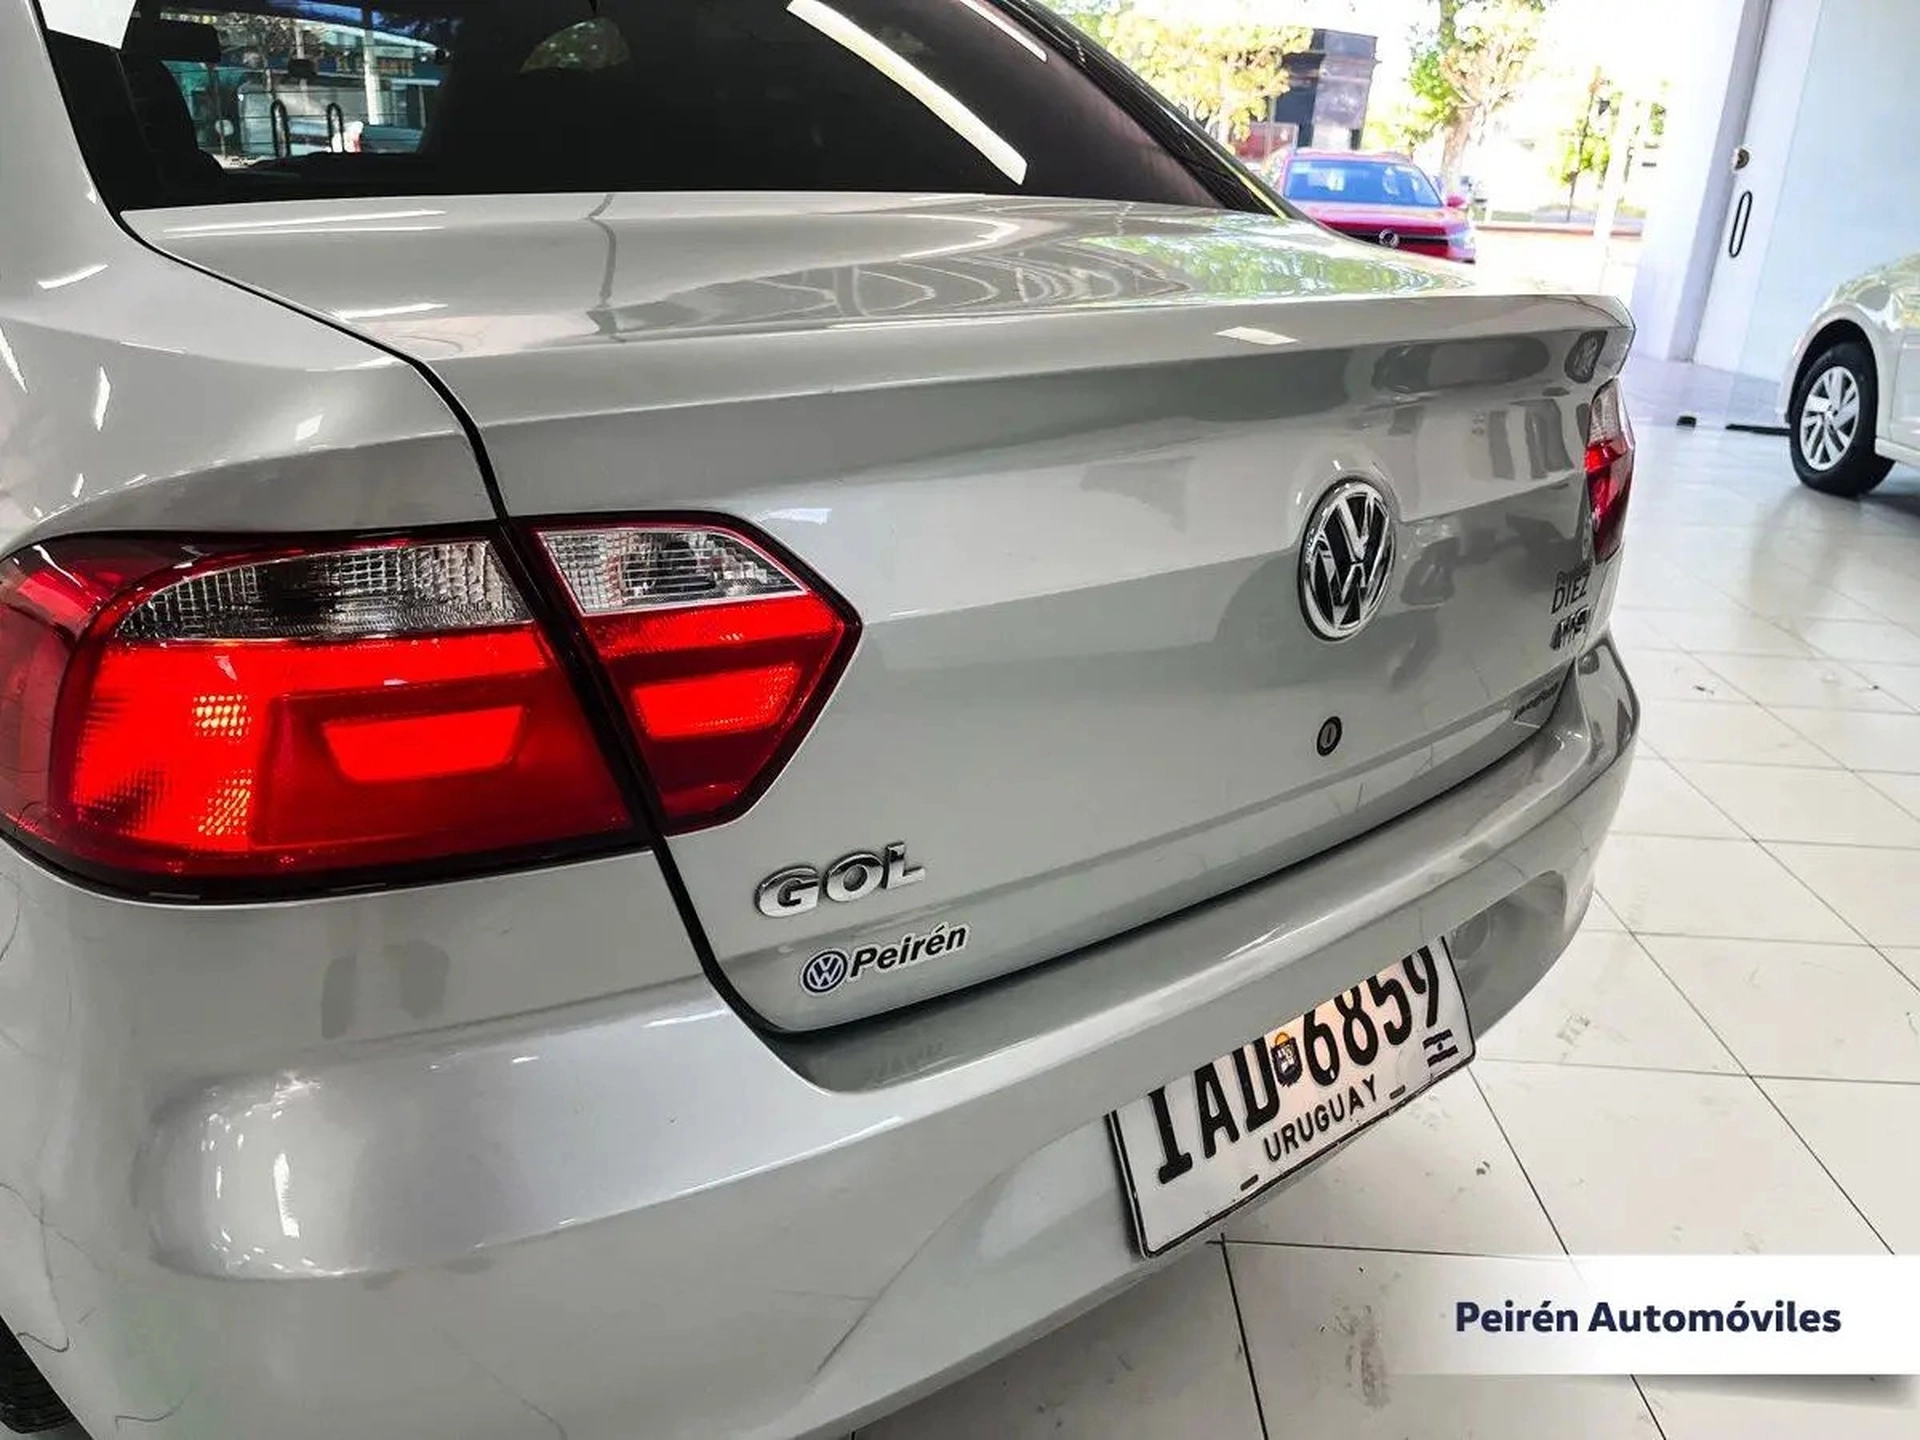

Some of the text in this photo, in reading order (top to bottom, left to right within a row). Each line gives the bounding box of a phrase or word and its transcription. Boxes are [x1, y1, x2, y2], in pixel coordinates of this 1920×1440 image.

[1298, 476, 1396, 641] VW
[754, 841, 926, 918] GOL
[850, 925, 967, 978] Peirén
[1263, 1073, 1379, 1162] URUGUAY
